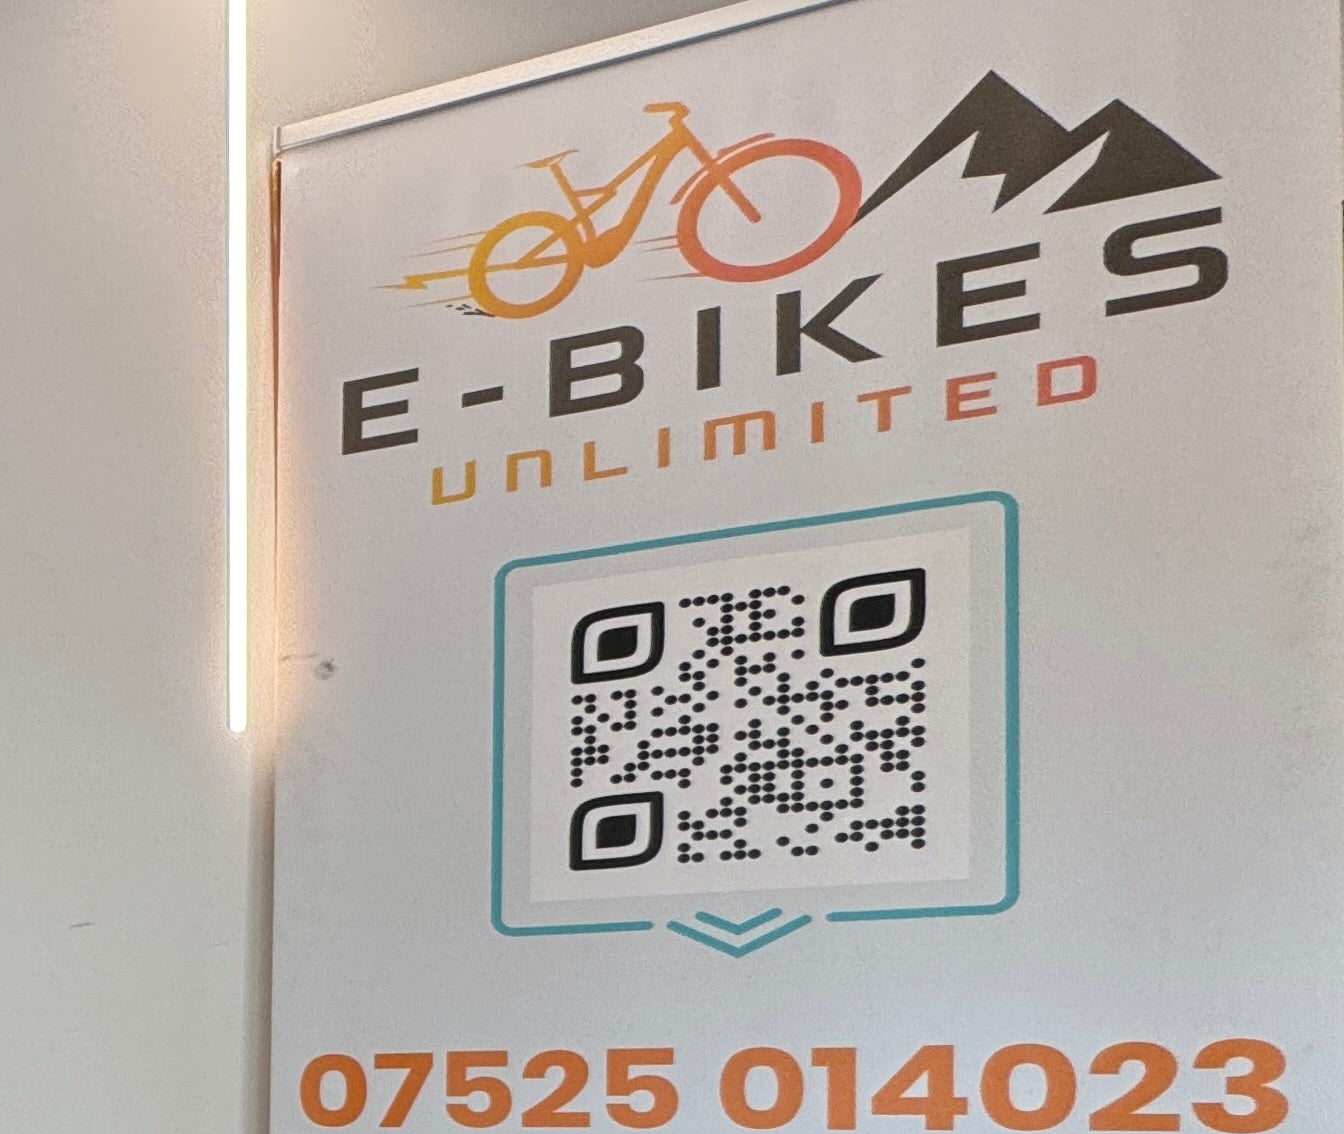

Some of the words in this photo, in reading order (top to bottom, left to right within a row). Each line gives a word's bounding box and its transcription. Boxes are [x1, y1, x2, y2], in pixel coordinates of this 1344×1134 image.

[341, 206, 1229, 456] E-BIKES
[431, 354, 1099, 507] UNLIMITED
[299, 1047, 679, 1129] 07525
[719, 1038, 1290, 1134] 014023
